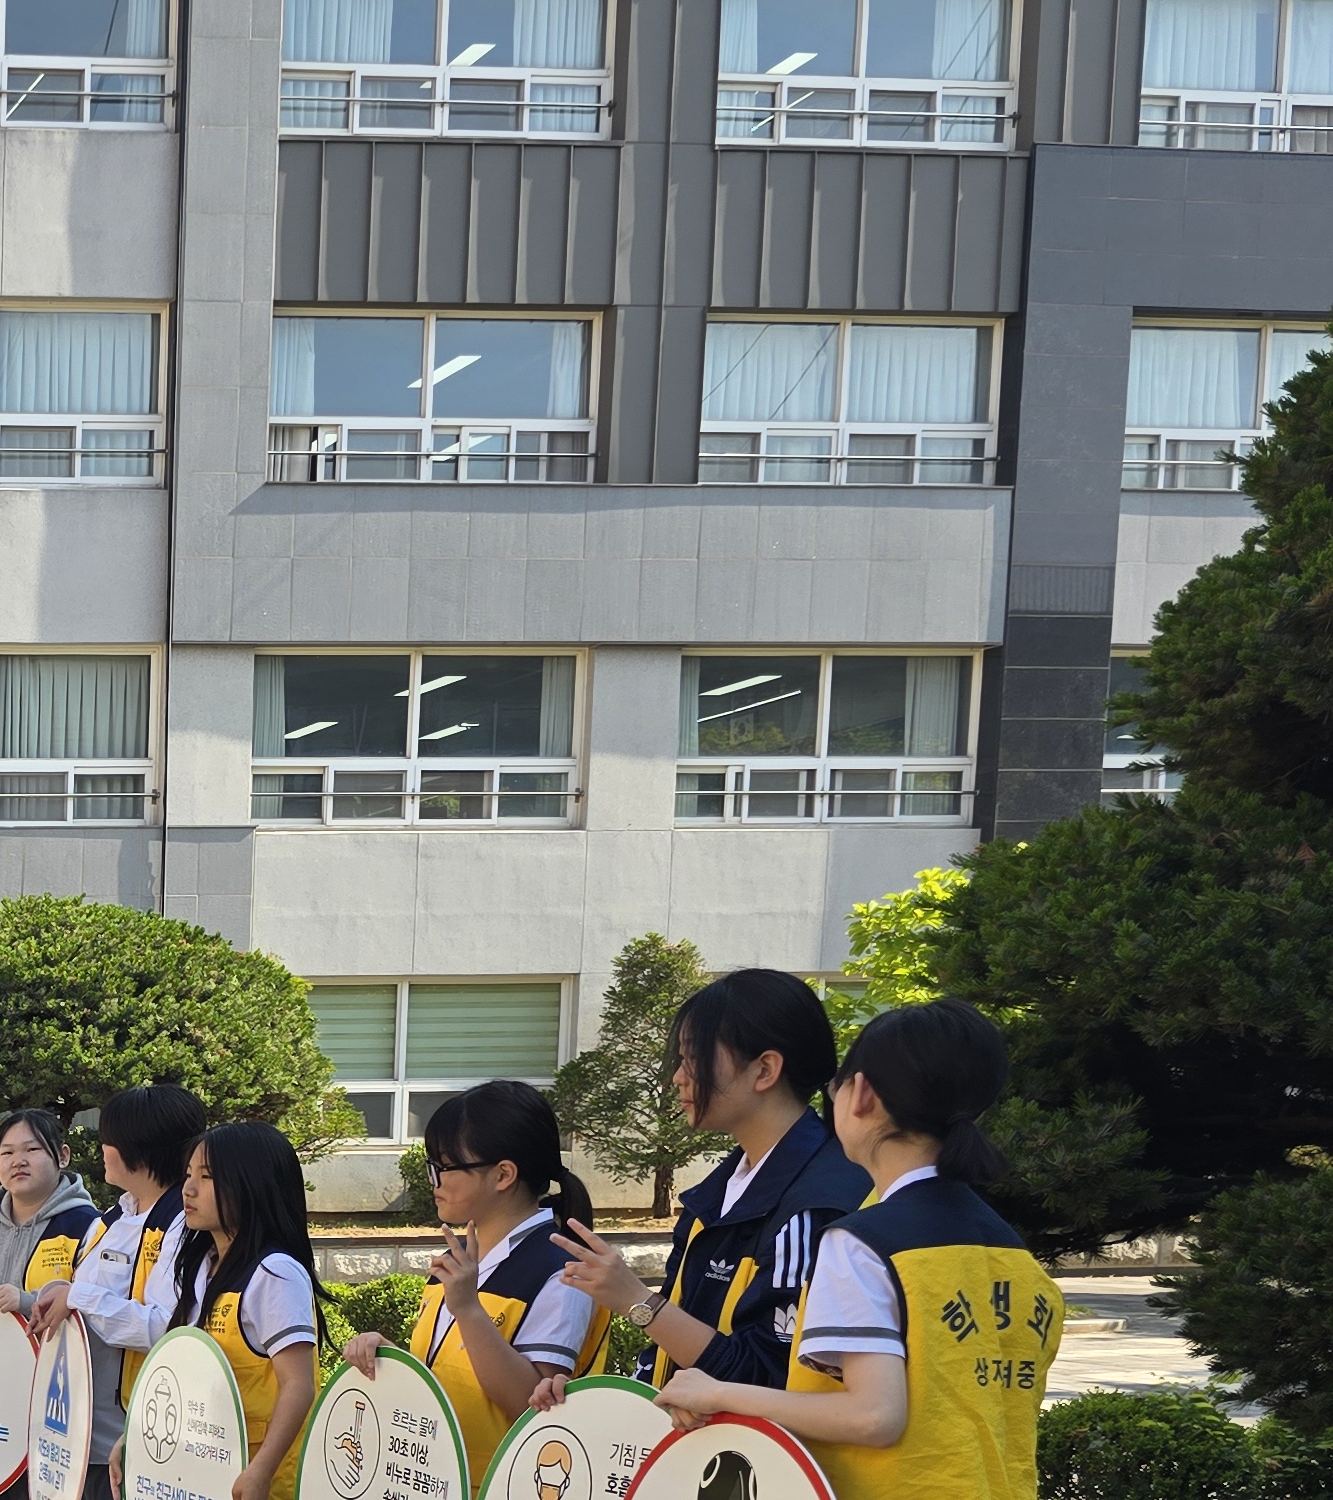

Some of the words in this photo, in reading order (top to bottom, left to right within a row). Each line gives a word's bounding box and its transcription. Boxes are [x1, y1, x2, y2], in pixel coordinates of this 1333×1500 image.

[704, 1271, 731, 1283] adidas
[187, 1400, 199, 1415] 악수
[199, 1402, 206, 1417] 등
[391, 1408, 418, 1434] 흐르는
[419, 1416, 438, 1441] 물에
[388, 1435, 409, 1458] 30초
[609, 1442, 637, 1468] 기침
[385, 1461, 412, 1487] 비누로
